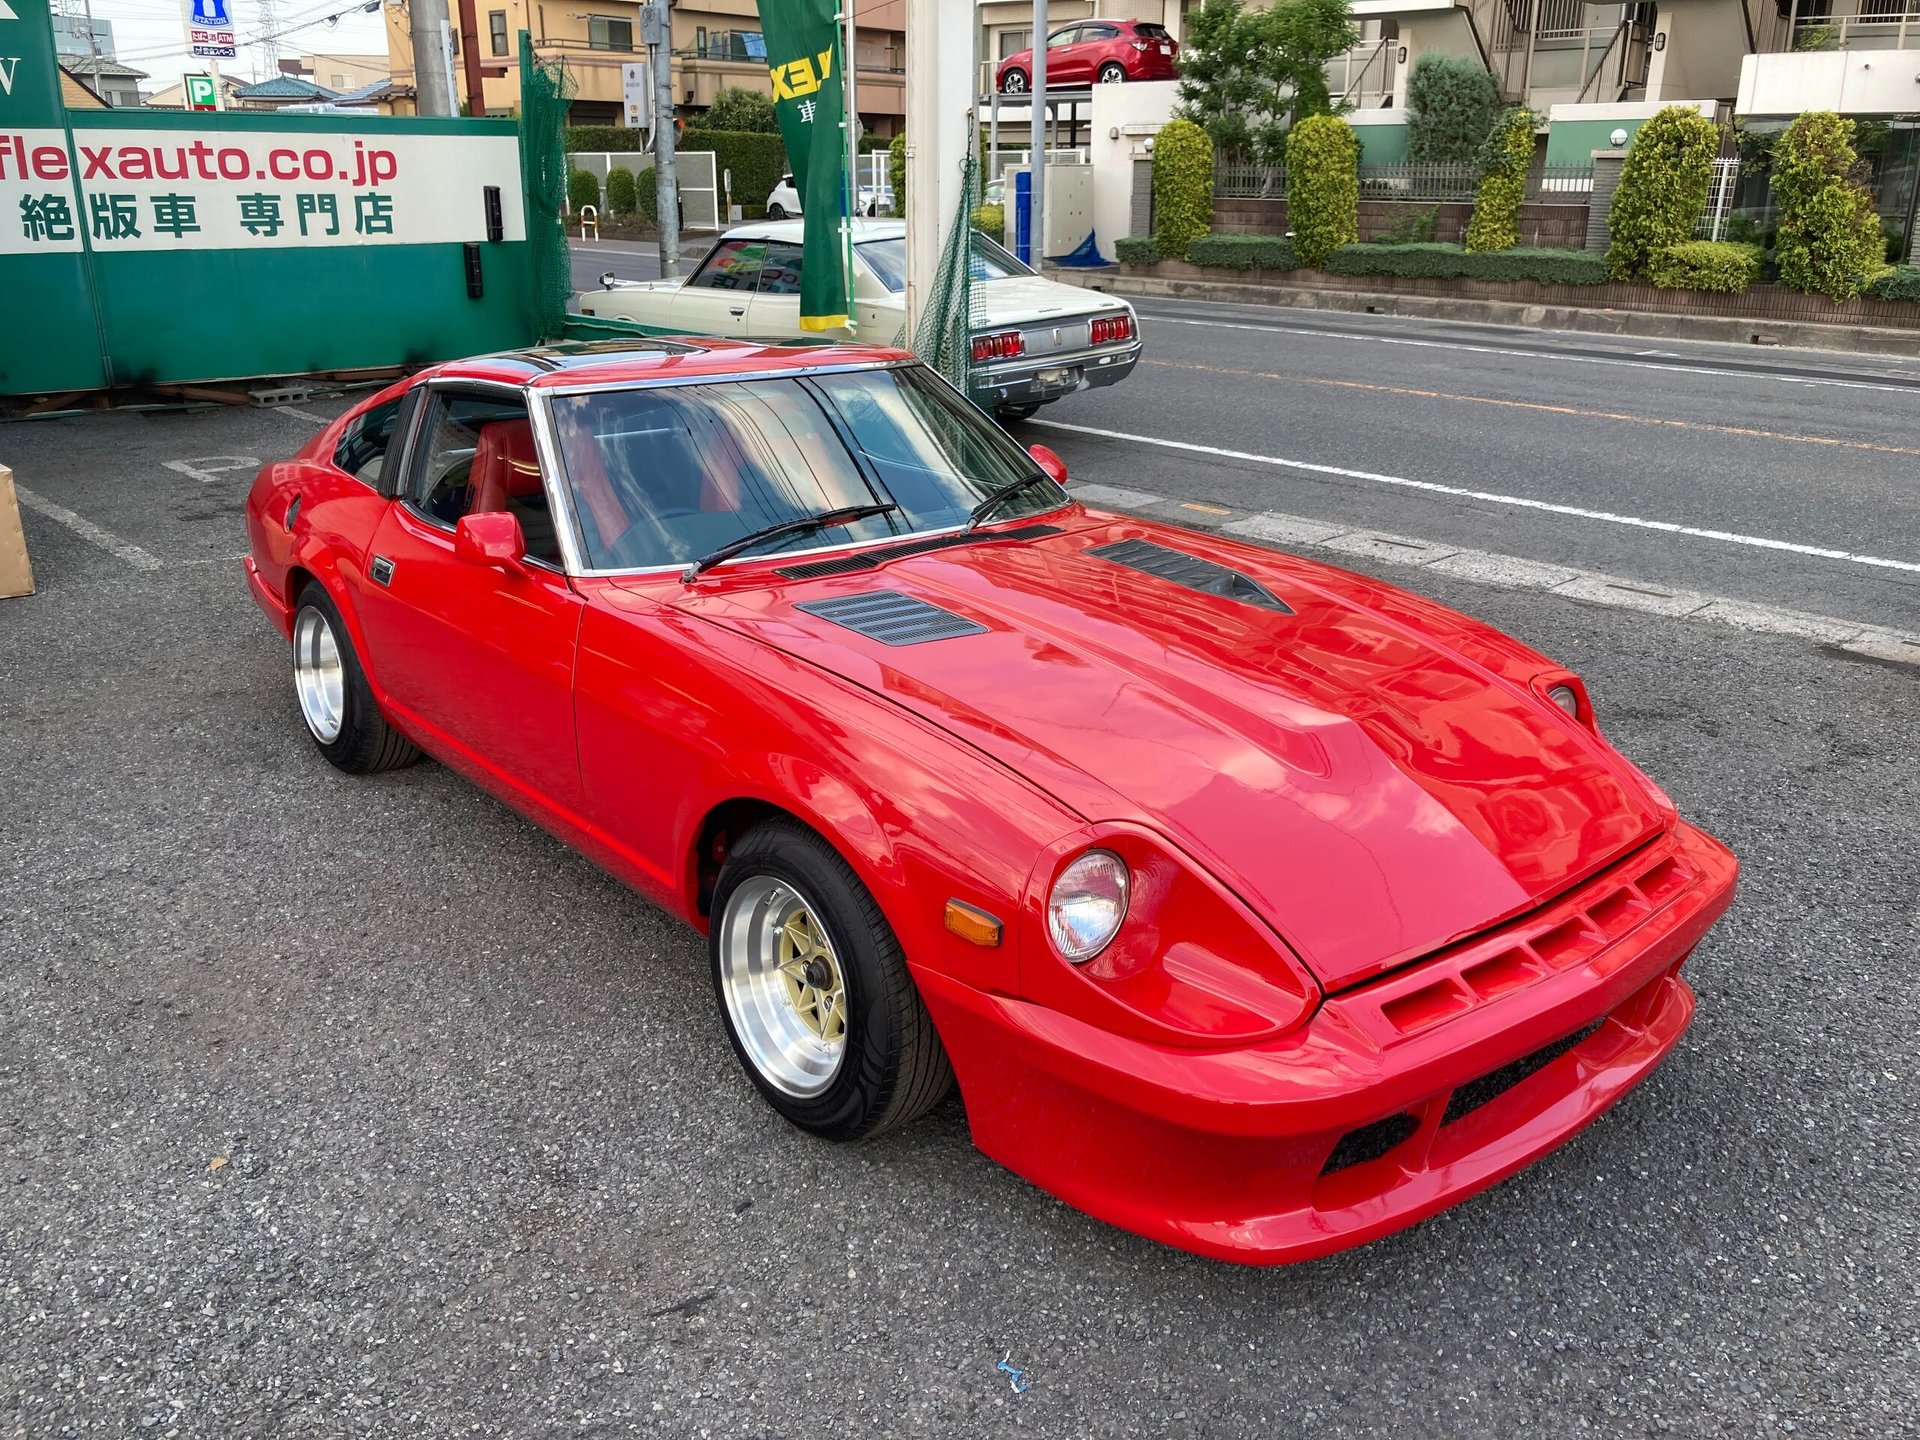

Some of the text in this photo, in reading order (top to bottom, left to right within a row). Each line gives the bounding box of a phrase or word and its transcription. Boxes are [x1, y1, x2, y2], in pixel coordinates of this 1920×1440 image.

[194, 14, 227, 25] STATION
[218, 34, 233, 43] ATM
[192, 81, 211, 103] P
[0, 135, 398, 187] flexauto.co.jp
[236, 191, 394, 238] 専門店
